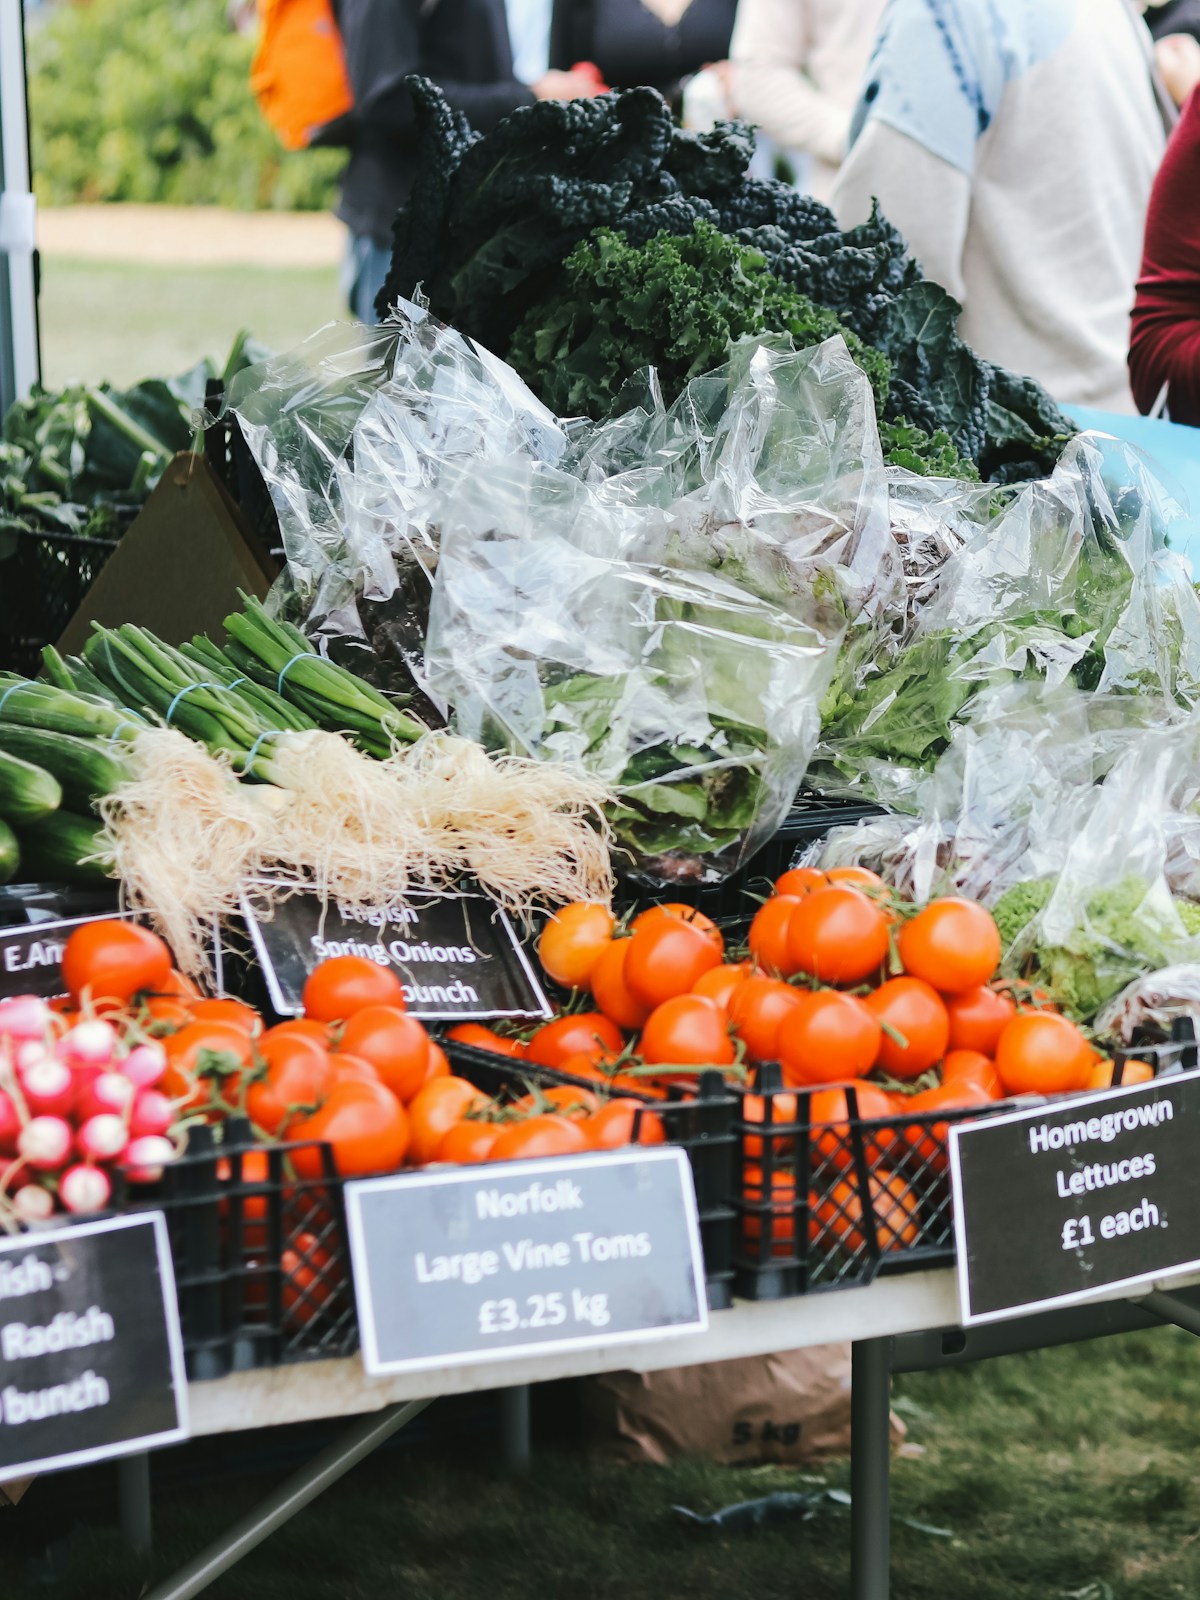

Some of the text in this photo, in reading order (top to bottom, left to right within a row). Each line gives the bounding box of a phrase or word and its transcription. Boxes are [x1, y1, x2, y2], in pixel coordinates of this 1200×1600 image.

[3, 941, 67, 972] E.An
[310, 935, 476, 966] Spring Onions
[1029, 1098, 1174, 1154] Homegrown
[1056, 1152, 1156, 1198] Lettuces
[475, 1178, 584, 1219] Norfolk
[1061, 1214, 1095, 1250] £1
[0, 1253, 52, 1298] ish
[415, 1232, 652, 1284] Large Vine Toms
[2, 1305, 115, 1361] Radish
[478, 1288, 611, 1334] £3.25 kg
[2, 1369, 110, 1424] bunch
